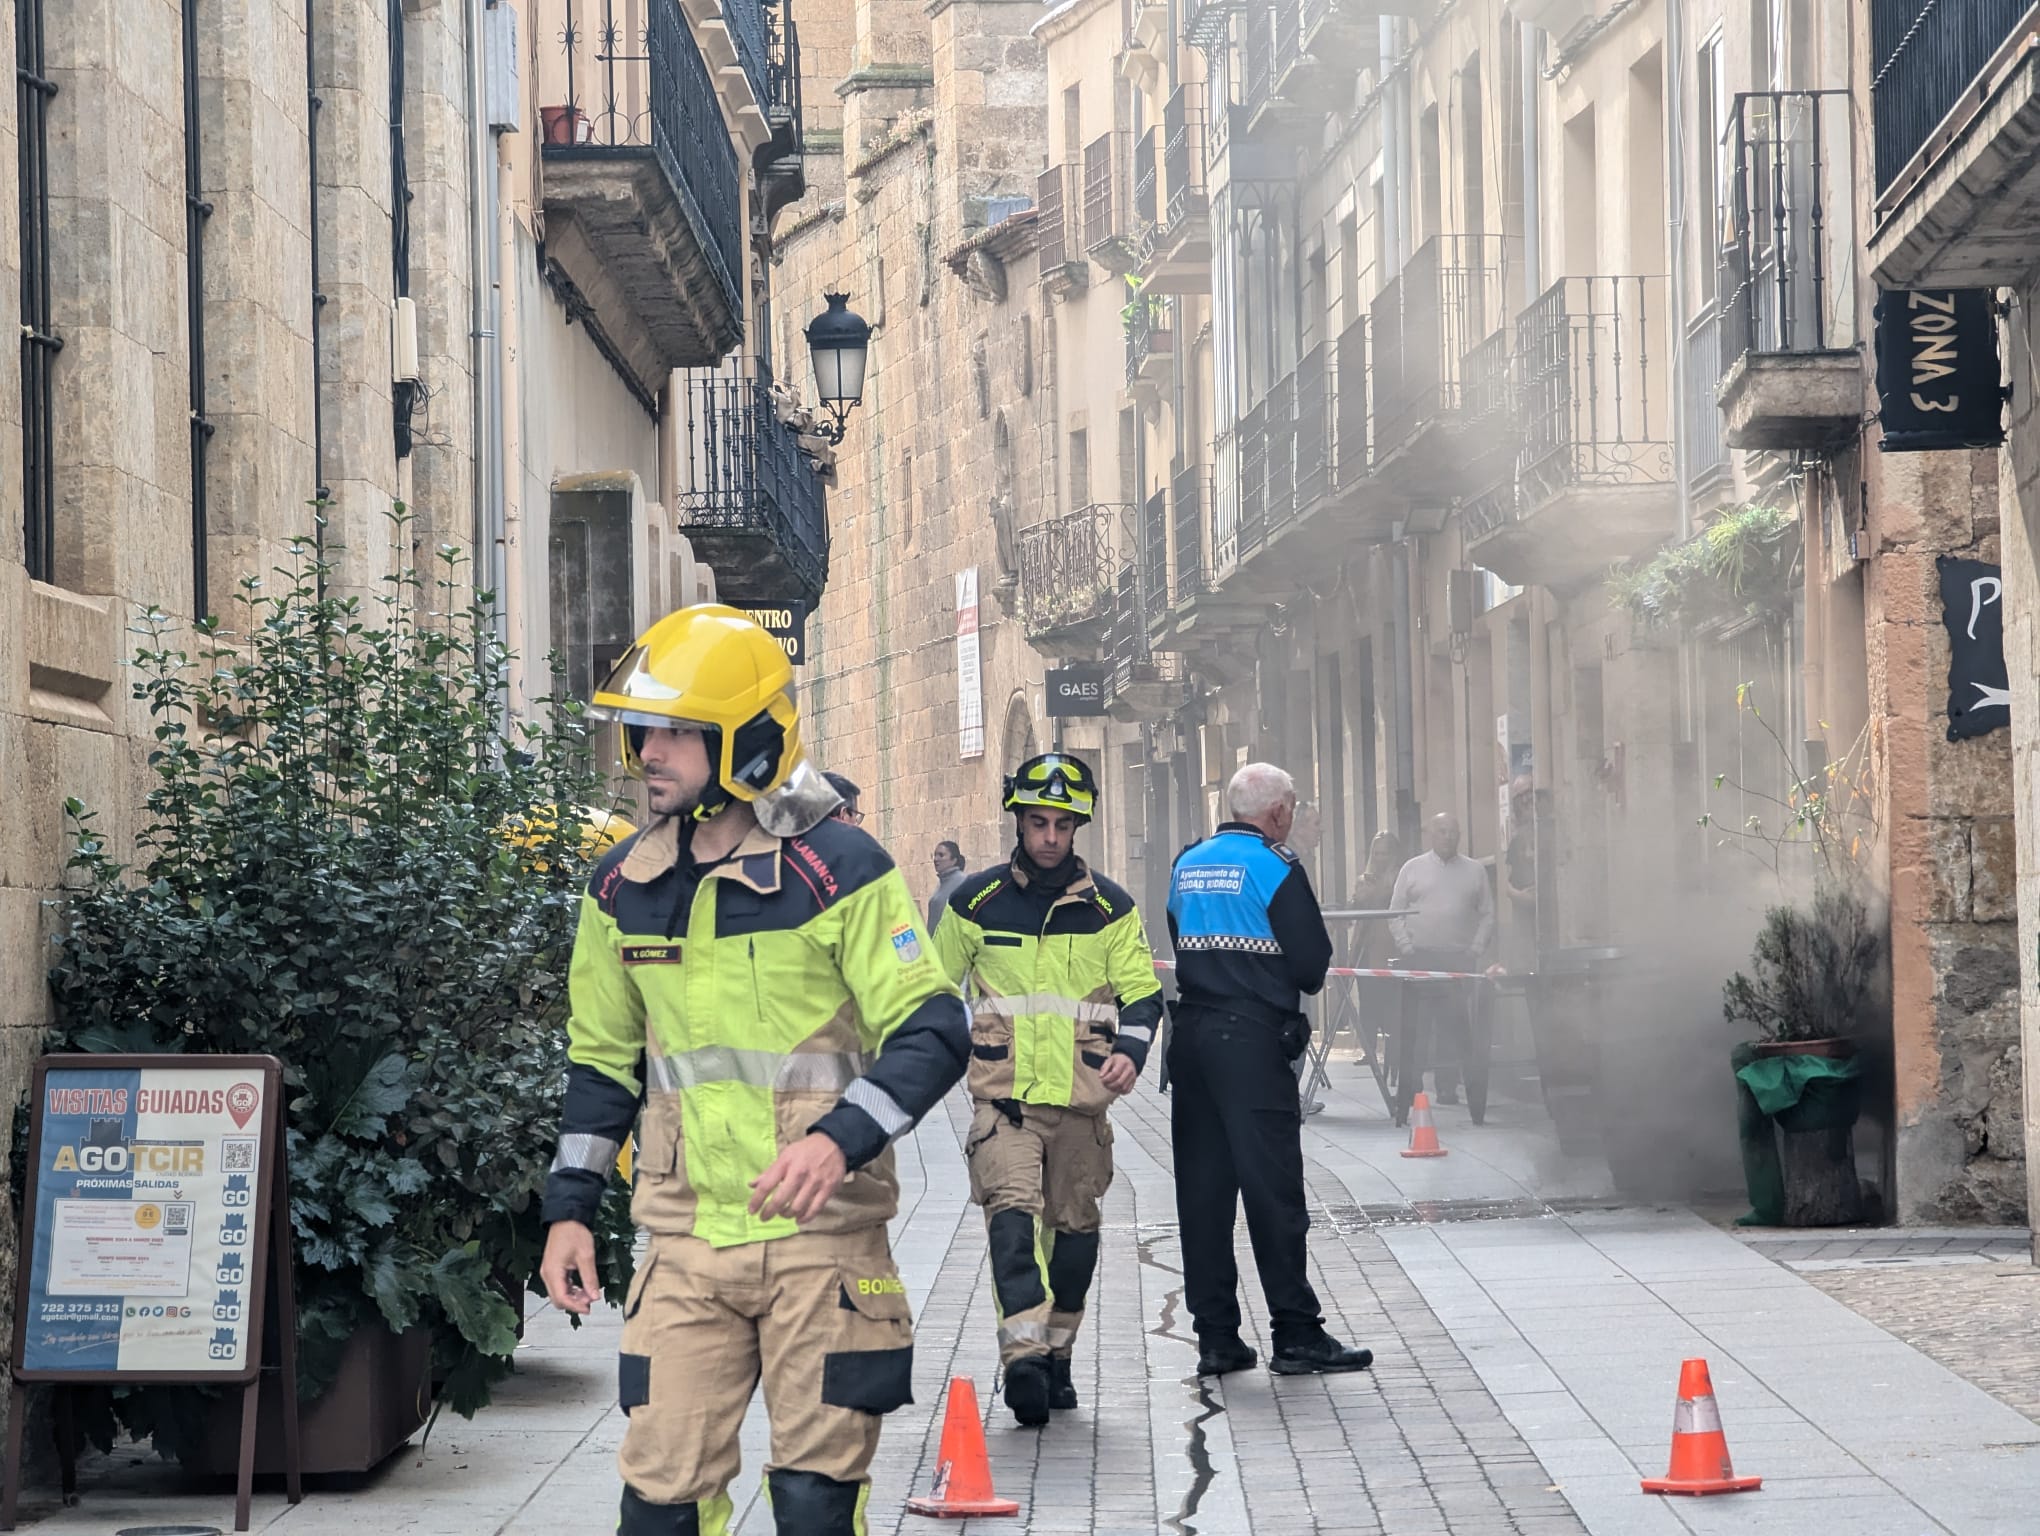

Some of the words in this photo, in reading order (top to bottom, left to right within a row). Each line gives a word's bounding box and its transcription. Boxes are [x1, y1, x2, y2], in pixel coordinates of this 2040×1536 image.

[1908, 291, 1958, 385] ZONA
[1910, 392, 1959, 412] 3
[1059, 682, 1099, 696] GAES
[1180, 868, 1228, 880] Ayuntamiento
[1229, 869, 1240, 878] de
[1178, 879, 1205, 890] CIUDAD
[1206, 879, 1239, 890] RODRIGO
[49, 1088, 128, 1115] VISITAS
[136, 1089, 224, 1115] GUIADAS
[52, 1145, 205, 1172] AGOTCIR
[76, 1178, 133, 1189] PRÓXIMAS
[134, 1179, 179, 1189] SALIDAS
[222, 1190, 249, 1205] GO
[219, 1229, 247, 1244] GO
[216, 1268, 243, 1282] GO
[41, 1303, 65, 1312] 722
[68, 1303, 92, 1312] 375
[95, 1303, 119, 1313] 313
[213, 1305, 240, 1319] GO
[209, 1343, 236, 1357] GO
